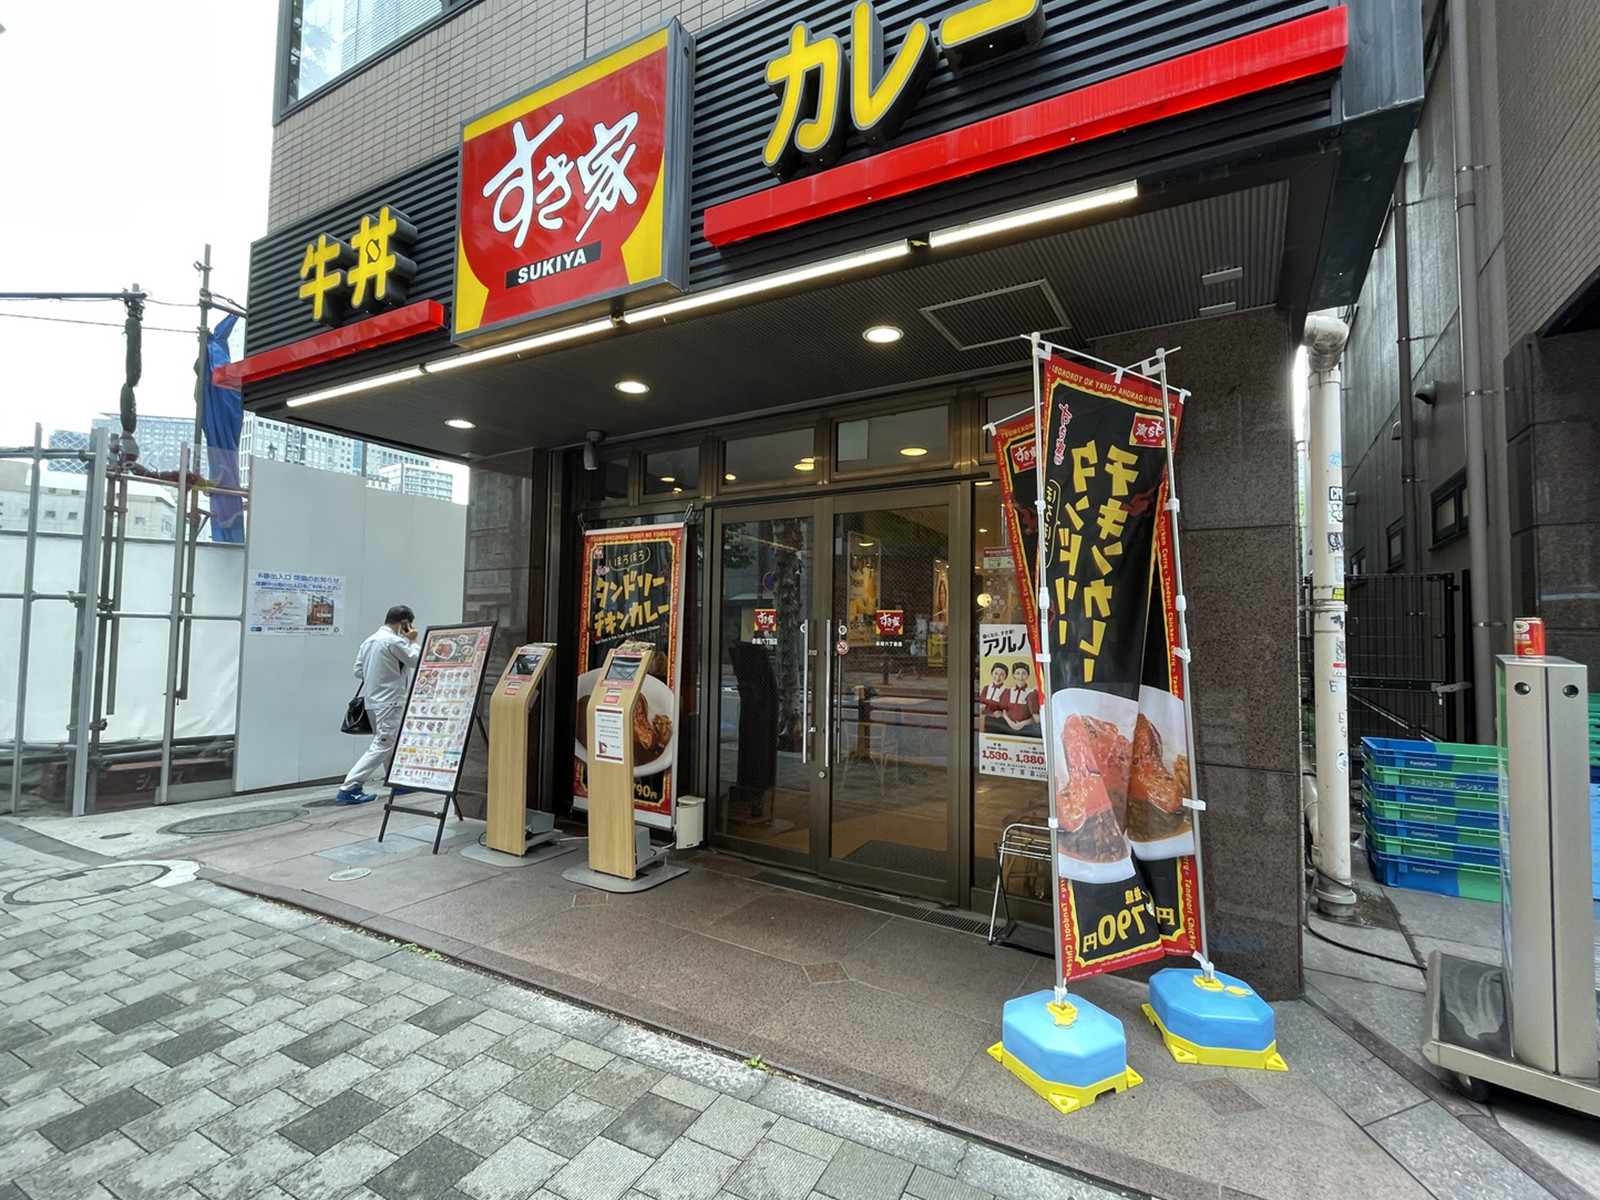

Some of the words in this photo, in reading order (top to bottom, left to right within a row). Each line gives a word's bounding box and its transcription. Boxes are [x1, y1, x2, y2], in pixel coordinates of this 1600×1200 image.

[761, 0, 1038, 167] カレー
[482, 111, 639, 250] すき家
[300, 205, 399, 323] 牛丼
[516, 247, 587, 285] SUKIYA
[614, 550, 645, 566] ほろほろ
[596, 571, 665, 608] タンドリー
[1164, 577, 1172, 610] Tandoori
[594, 600, 670, 637] チキンカレー
[982, 750, 1008, 761] 1,530
[1015, 753, 1044, 764] 1,380
[1410, 778, 1484, 791] ファミリーコーポレーション
[1185, 880, 1194, 914] Tandoori
